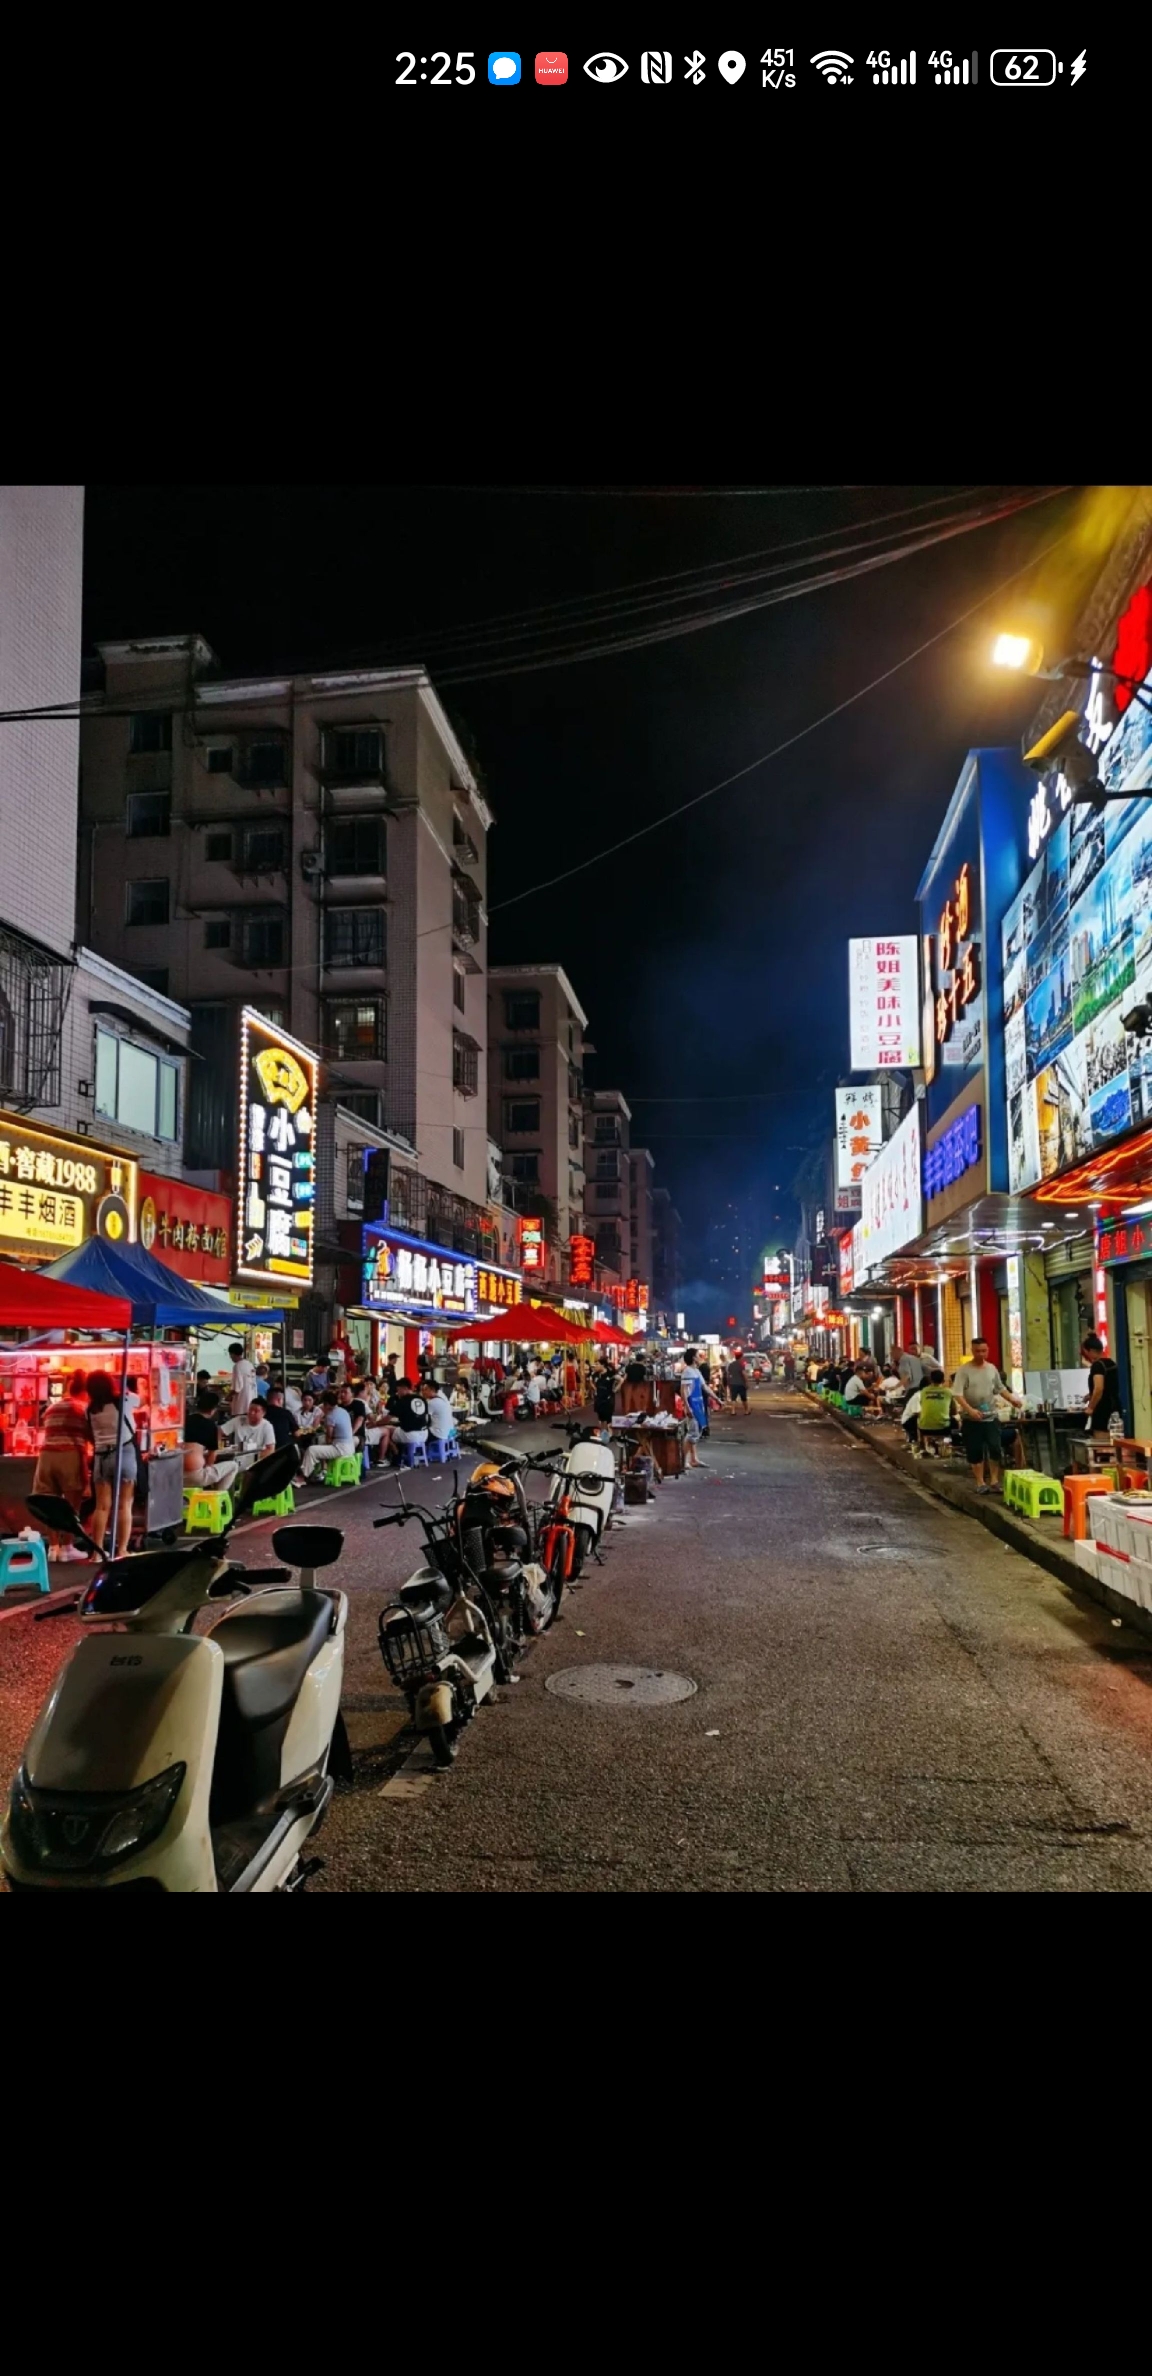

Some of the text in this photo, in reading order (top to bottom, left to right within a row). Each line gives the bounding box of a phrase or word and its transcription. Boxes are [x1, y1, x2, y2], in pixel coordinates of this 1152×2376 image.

[875, 941, 902, 1064] 陈姐美味小豆腐
[268, 1107, 296, 1256] 小豆腐
[849, 1110, 871, 1182] 小黄鱼
[1100, 1224, 1152, 1260] 唐姐小
